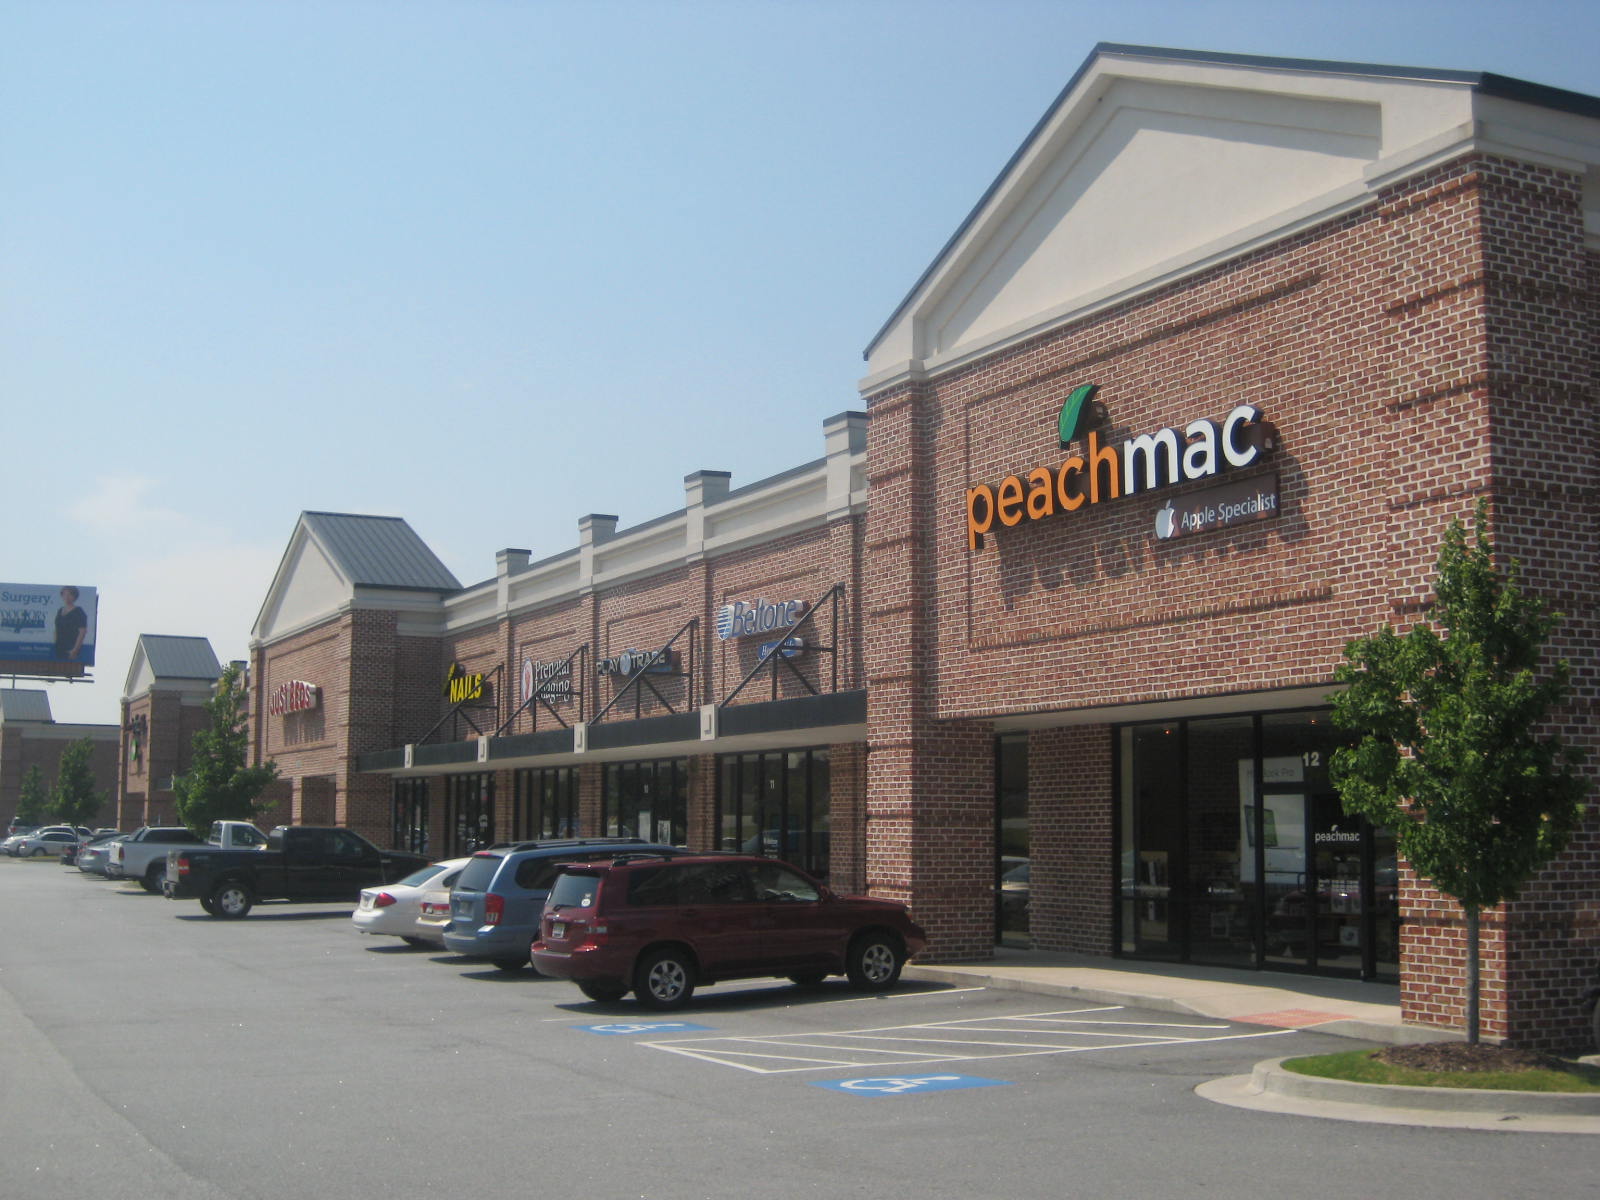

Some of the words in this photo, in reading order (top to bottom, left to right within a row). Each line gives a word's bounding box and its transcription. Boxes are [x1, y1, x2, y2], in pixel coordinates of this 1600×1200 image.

[966, 404, 1258, 550] peachmac
[1181, 506, 1215, 531] Apple
[1218, 493, 1275, 523] Specialist
[732, 599, 797, 637] Beltone
[270, 682, 290, 717] JUST
[290, 680, 310, 711] BEDS
[450, 673, 482, 703] NAILS
[1303, 752, 1320, 767] 12
[1315, 830, 1360, 843] peachmac
